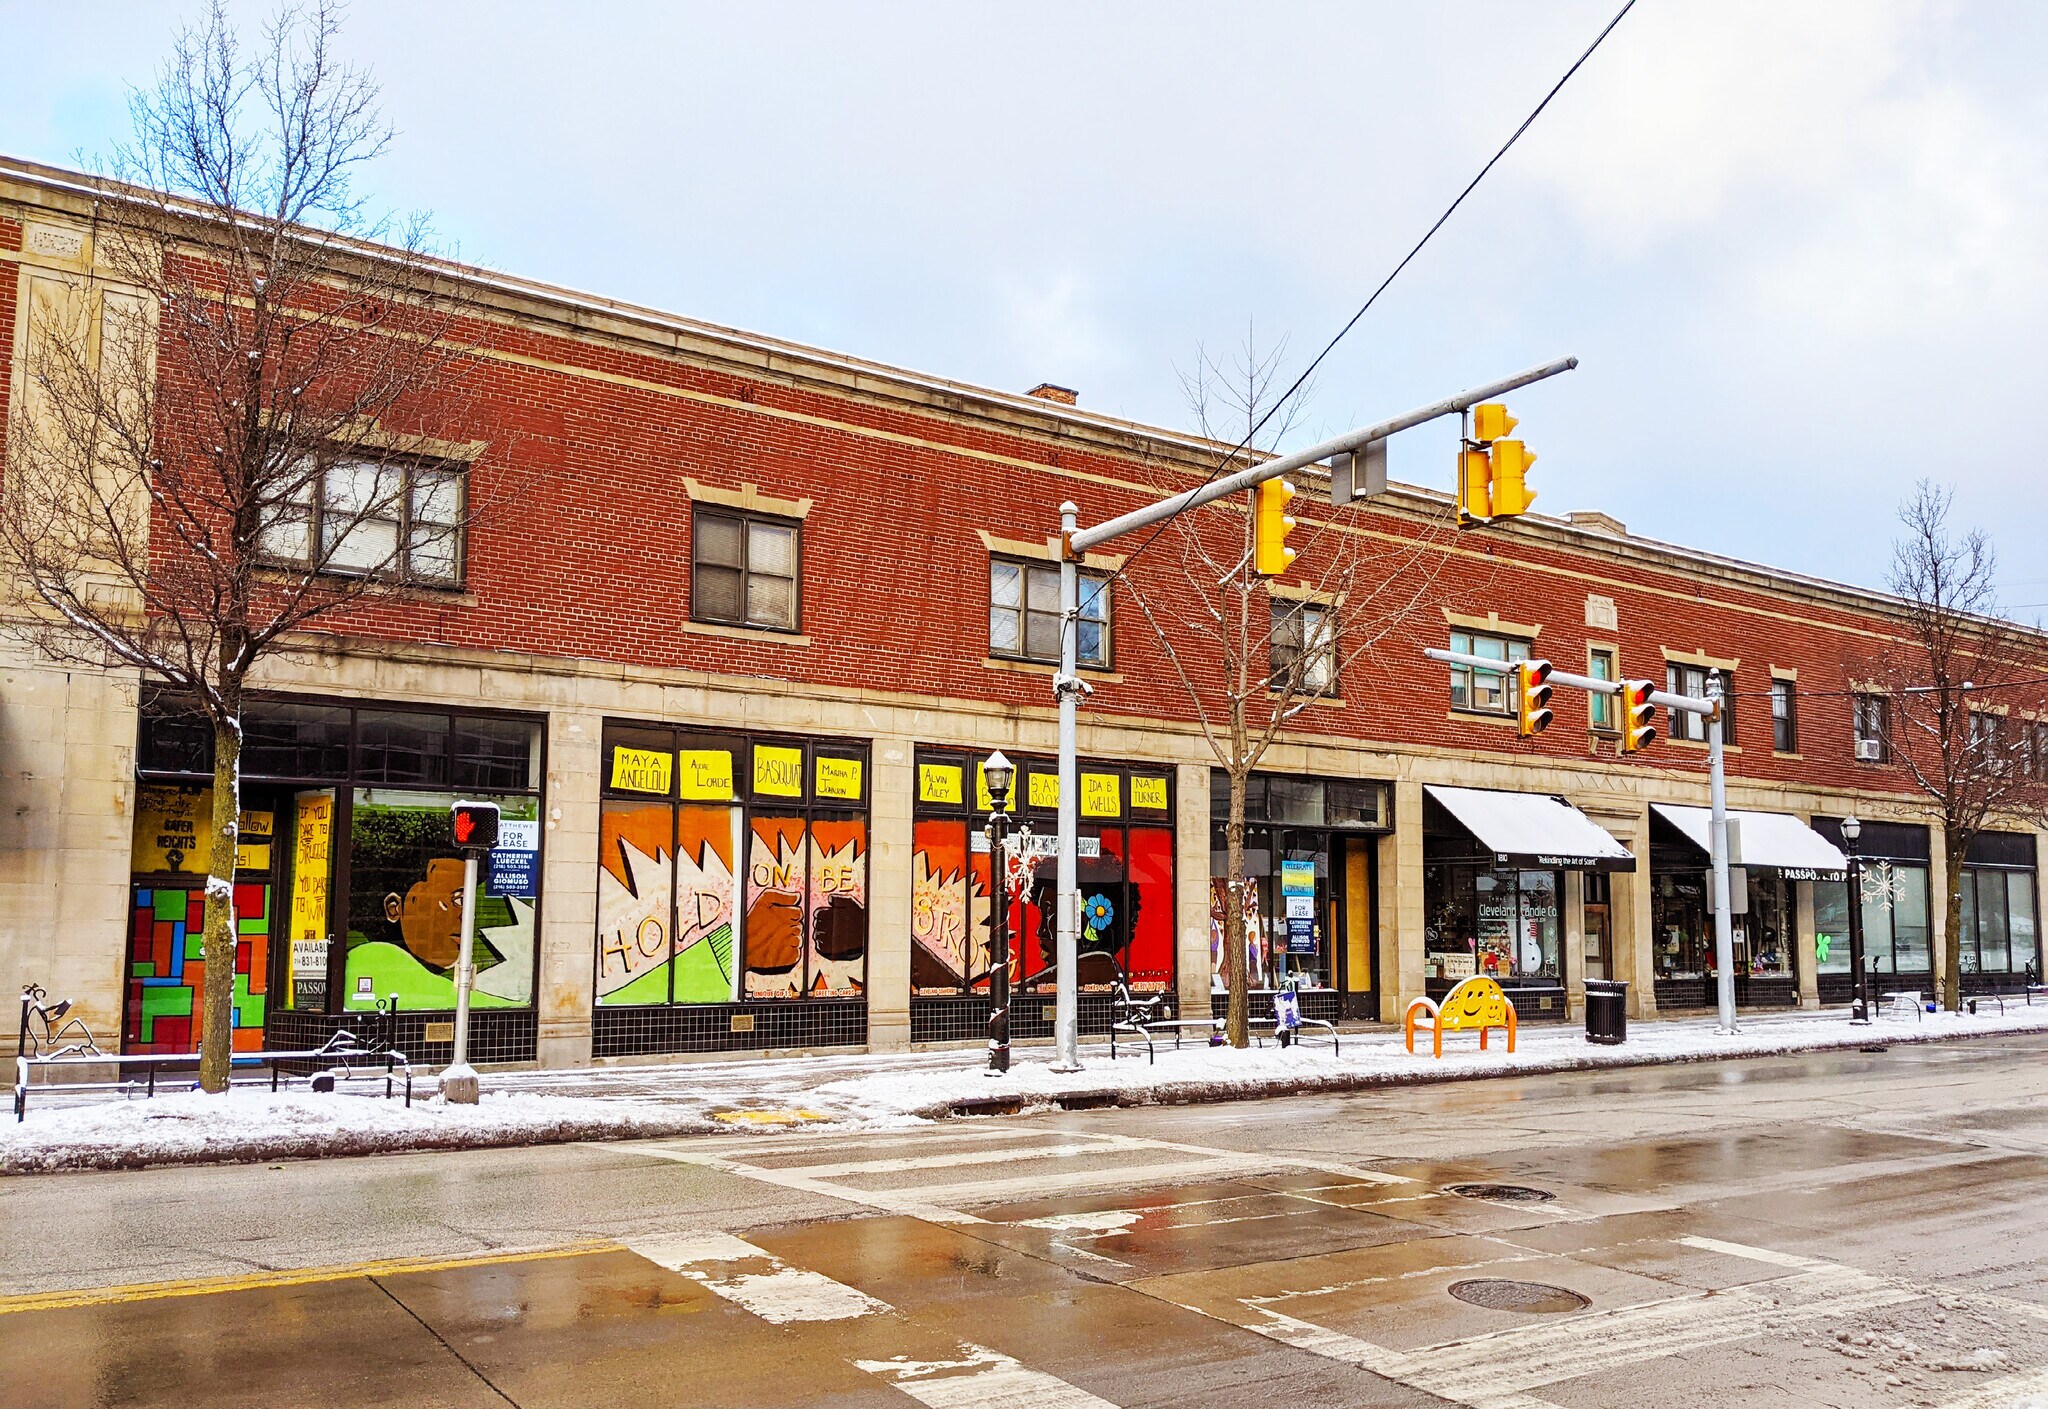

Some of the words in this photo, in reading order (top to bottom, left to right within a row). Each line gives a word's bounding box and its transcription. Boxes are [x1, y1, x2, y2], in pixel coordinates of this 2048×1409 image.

[621, 754, 661, 769] MAYA
[618, 768, 667, 791] ANGELOU
[696, 769, 731, 788] LORDE
[757, 757, 802, 788] BASQUIAT
[1088, 779, 1103, 792] IDA
[1135, 778, 1158, 789] NAT
[1031, 792, 1059, 806] COOK
[1088, 795, 1117, 812] WELLS
[1134, 791, 1163, 804] TURNER
[300, 806, 308, 819] IF
[313, 804, 328, 820] YOU
[237, 811, 269, 832] ollow
[300, 823, 315, 838] DARE
[319, 823, 327, 835] TO
[503, 831, 523, 840] FOR
[157, 835, 196, 849] HEIGHTS
[1077, 838, 1099, 855] APPY
[491, 852, 533, 860] CATHERINE
[752, 862, 793, 888] ON
[819, 865, 854, 892] BE
[1784, 868, 1827, 880] PASSPO
[307, 899, 325, 921] WIN
[1479, 903, 1517, 917] Cleveland
[1520, 904, 1546, 917] Candle
[600, 891, 724, 978] HOLD
[293, 942, 327, 953] AVAILABL
